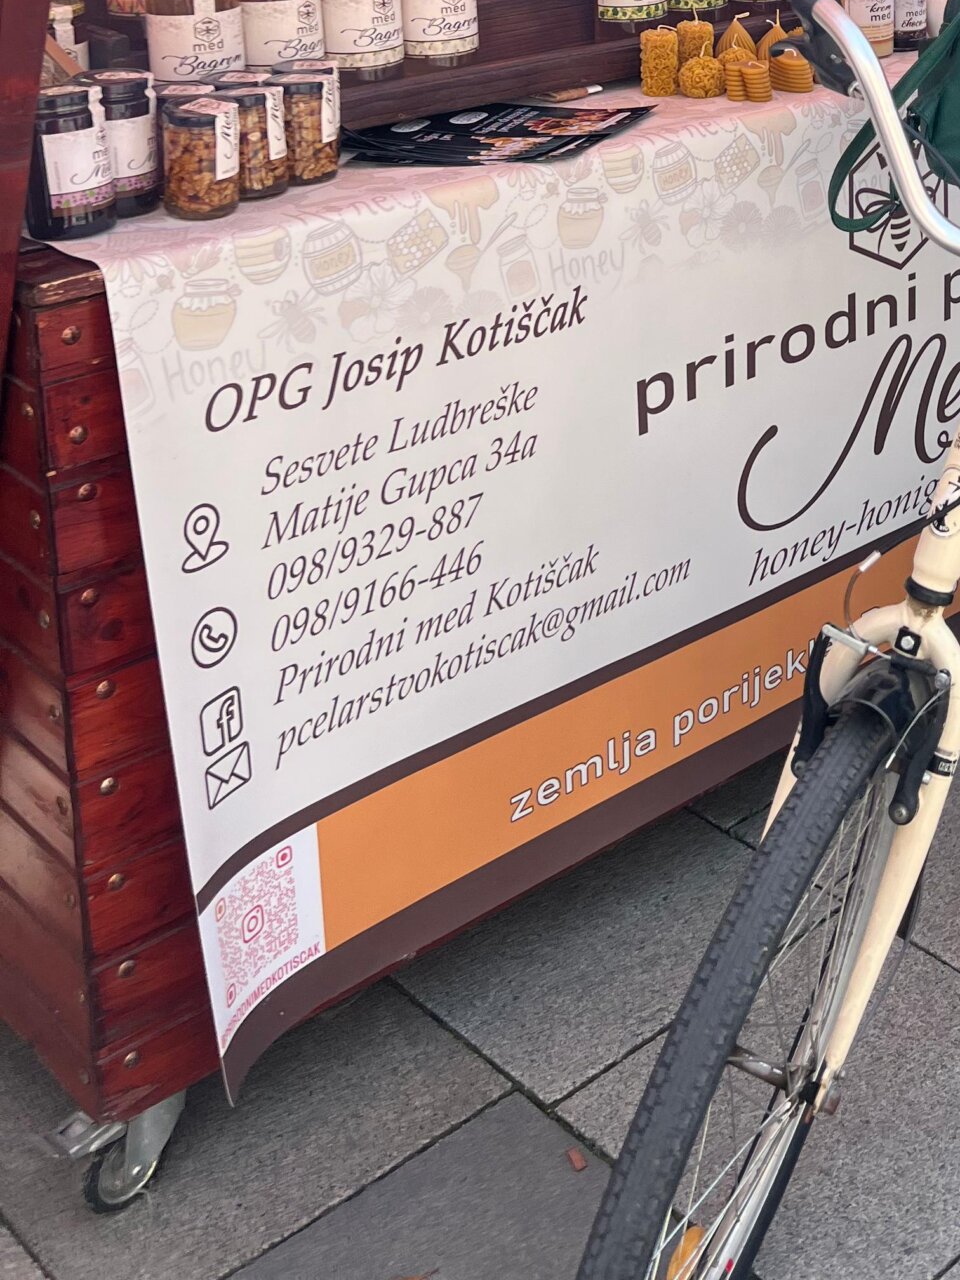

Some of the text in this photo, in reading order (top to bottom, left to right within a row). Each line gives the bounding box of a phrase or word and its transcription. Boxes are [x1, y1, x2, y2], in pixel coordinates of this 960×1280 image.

[192, 39, 225, 52] med
[296, 22, 319, 35] med
[371, 12, 396, 25] med
[440, 2, 466, 15] med
[870, 12, 891, 22] med
[204, 285, 588, 434] OPG Josip Kotiščak
[636, 272, 918, 436] prirodni
[260, 382, 539, 496] Sesvete Ludbreške
[260, 433, 538, 551] Matije Gupca 34a
[267, 493, 485, 600] 098/9329-887
[270, 541, 485, 653] 098/9166-446
[272, 543, 600, 708] Prirodni med Kotiščak
[274, 557, 692, 771] pcelarstvokotiscak@gmail.com
[508, 725, 657, 823] zemlja
